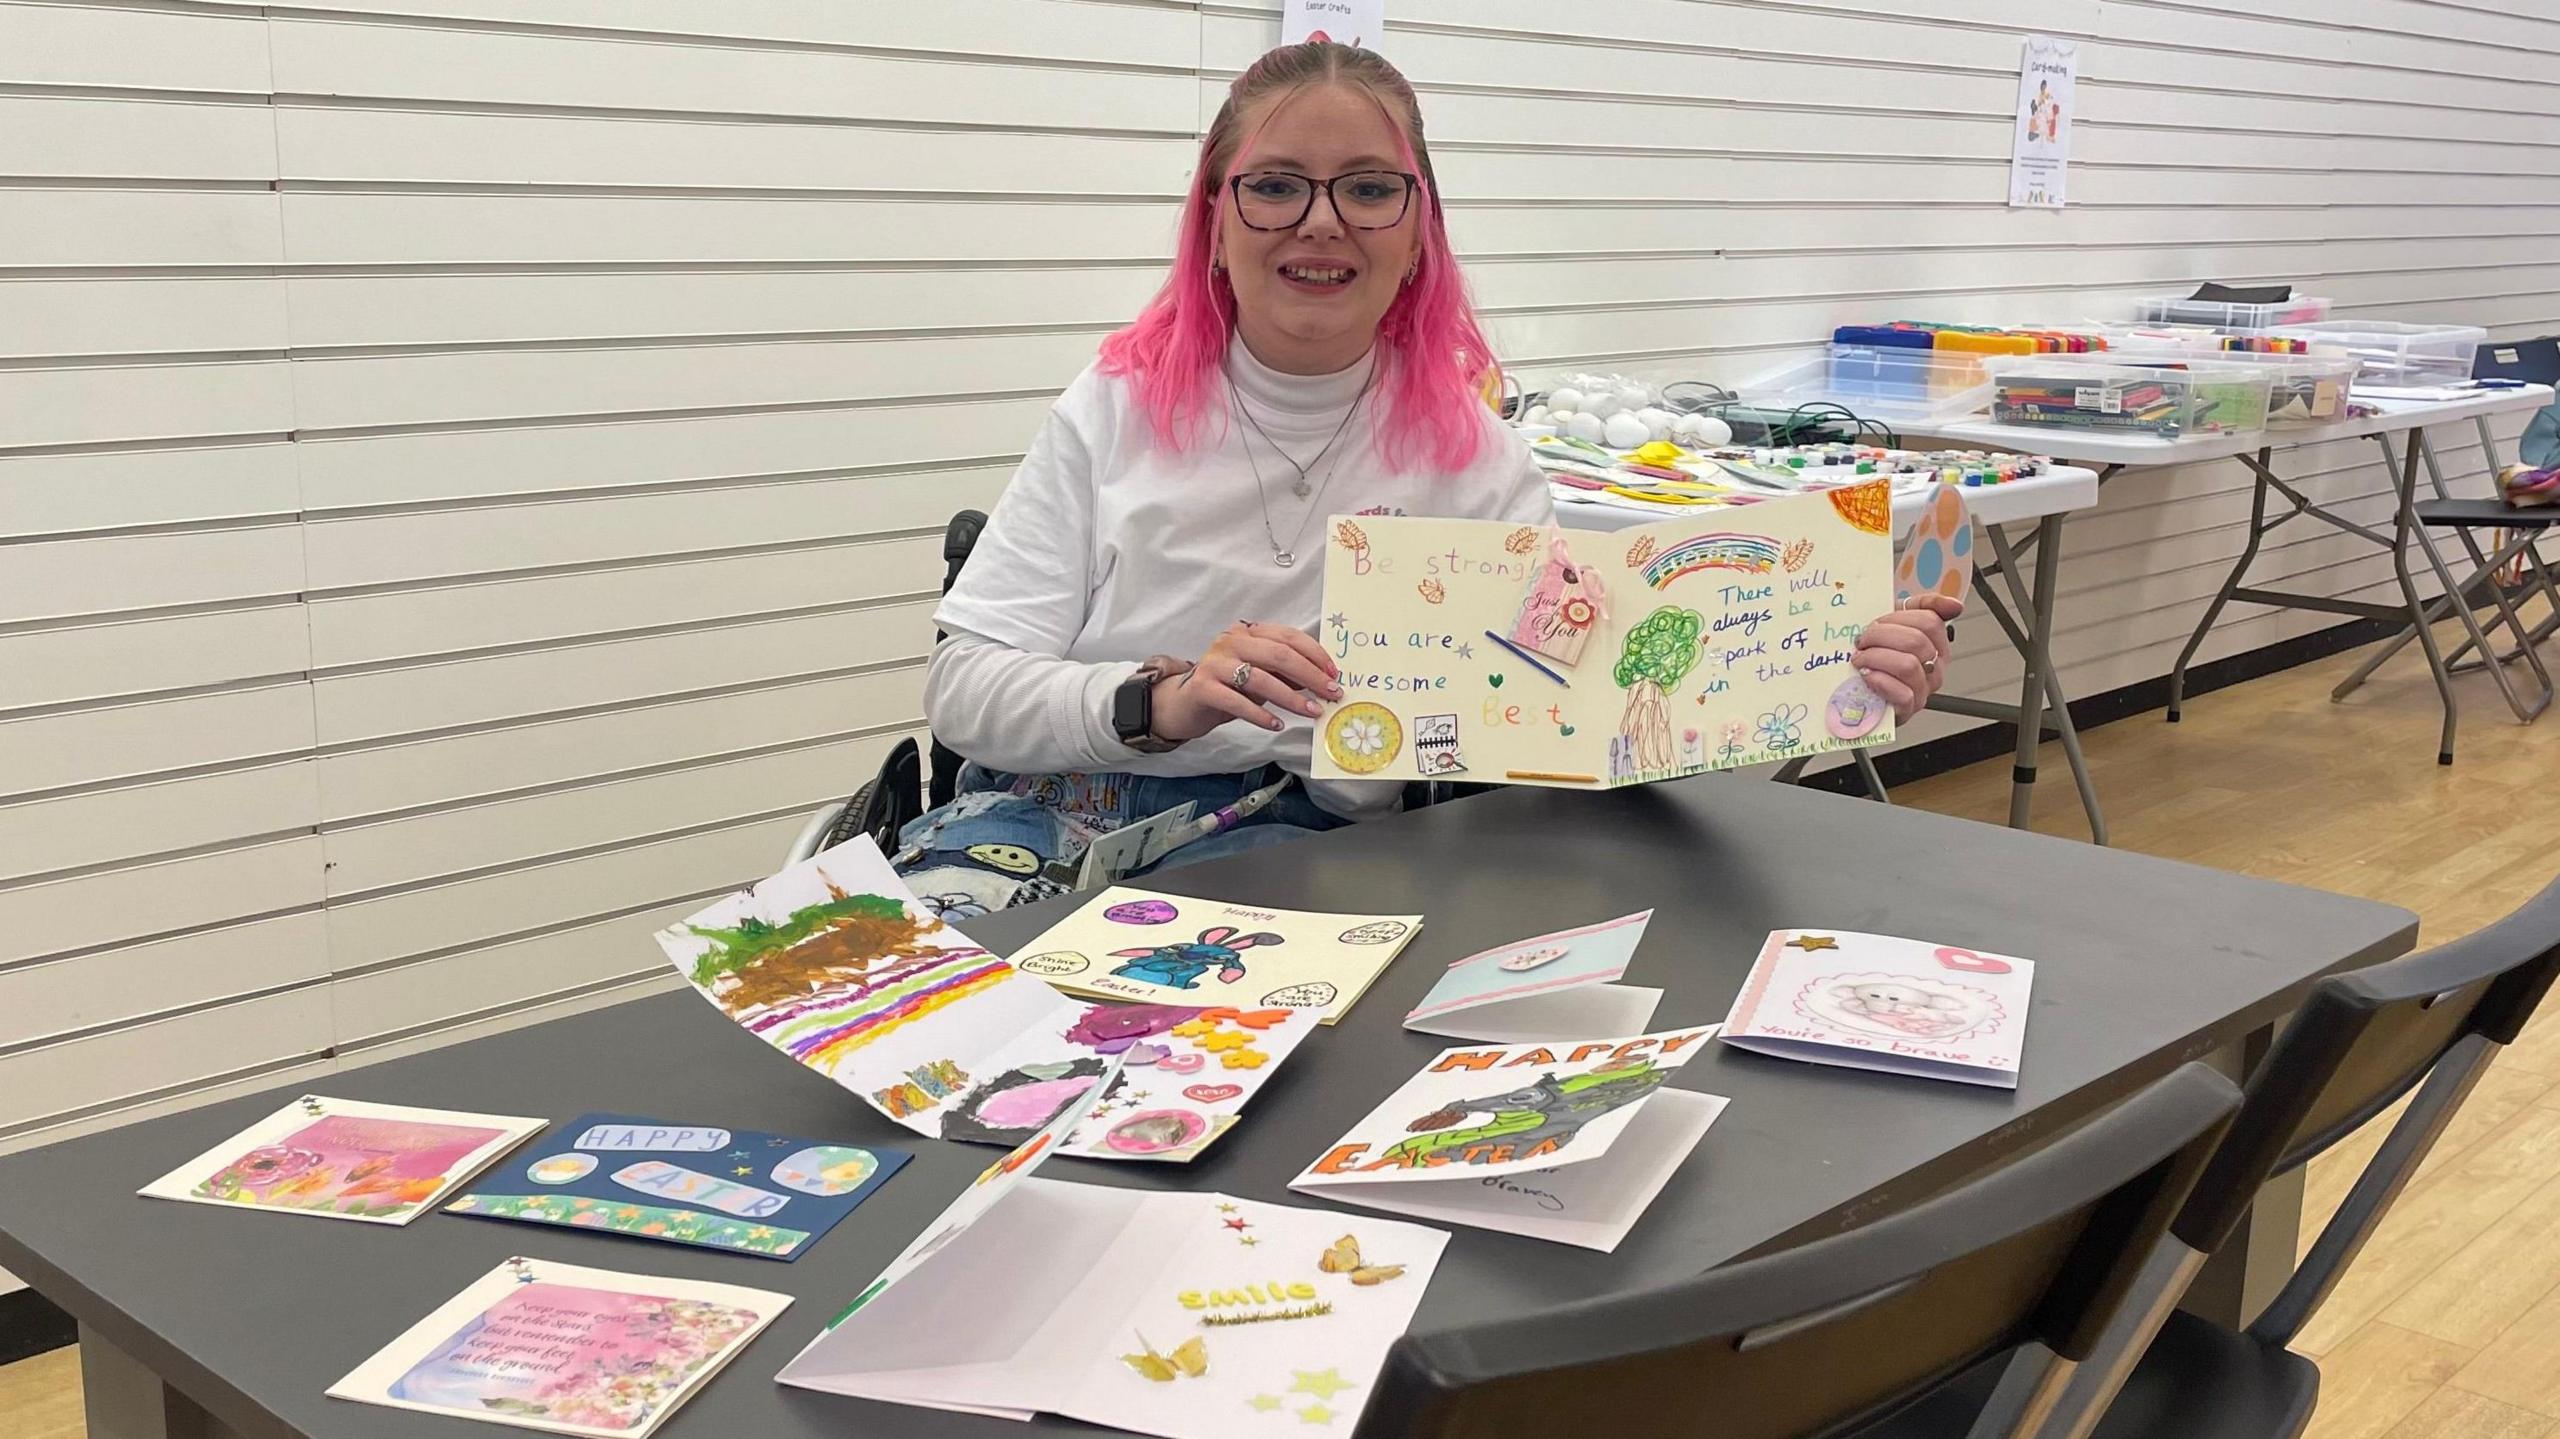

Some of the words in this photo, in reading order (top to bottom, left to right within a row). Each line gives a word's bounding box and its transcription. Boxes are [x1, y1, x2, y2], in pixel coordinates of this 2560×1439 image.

[1354, 542, 1397, 576] Be
[1523, 591, 1561, 611] Just
[1717, 585, 1774, 606] There
[1789, 569, 1831, 593] will
[1788, 600, 1815, 616] be
[1830, 593, 1847, 607] a
[1531, 612, 1579, 643] You
[1336, 628, 1388, 659] you
[1408, 629, 1454, 649] are
[1703, 675, 1730, 694] in
[1755, 662, 1793, 682] the
[1482, 695, 1565, 726] Best
[1427, 1031, 1708, 1073] HAPPY
[1842, 1037, 1872, 1047] so
[1890, 1040, 1971, 1063] brave
[582, 1128, 727, 1152] HAPPY
[1308, 1138, 1565, 1174] EASTER
[619, 1161, 783, 1217] EASTER
[522, 1315, 550, 1326] the
[553, 1308, 589, 1319] your
[483, 1324, 512, 1336] but
[514, 1330, 594, 1347] remember
[472, 1351, 498, 1365] the
[500, 1359, 570, 1374] ground
[504, 1344, 539, 1355] your
[540, 1344, 576, 1360] feet
